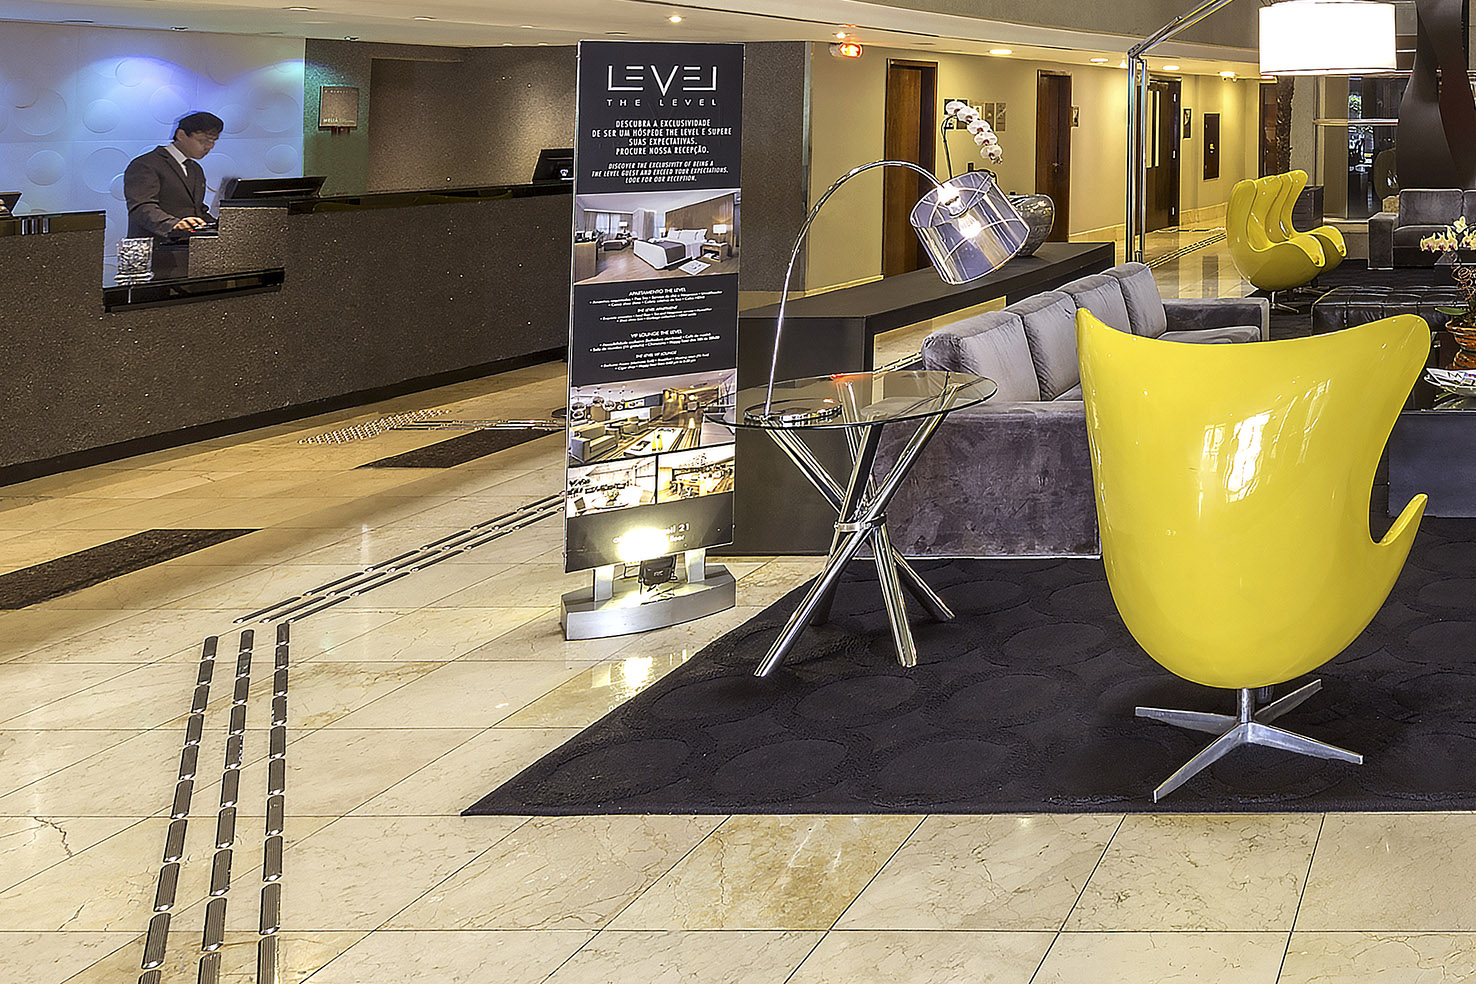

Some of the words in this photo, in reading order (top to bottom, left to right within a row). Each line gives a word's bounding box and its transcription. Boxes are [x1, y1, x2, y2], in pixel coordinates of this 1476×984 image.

[608, 65, 717, 96] LEVEL
[607, 99, 641, 107] THE
[616, 120, 651, 128] DESCUBRA
[652, 120, 658, 128] A
[660, 119, 711, 127] EXCLUSIVIDADE
[604, 129, 616, 137] SER
[619, 129, 630, 137] UM
[632, 128, 663, 136] HÓSPEDE
[666, 128, 678, 136] THE
[680, 128, 699, 136] LEVEL
[628, 138, 646, 146] SUAS
[649, 137, 698, 145] EXPECTATIVAS.
[616, 147, 646, 155] PROCURE
[649, 146, 672, 154] NOSSA
